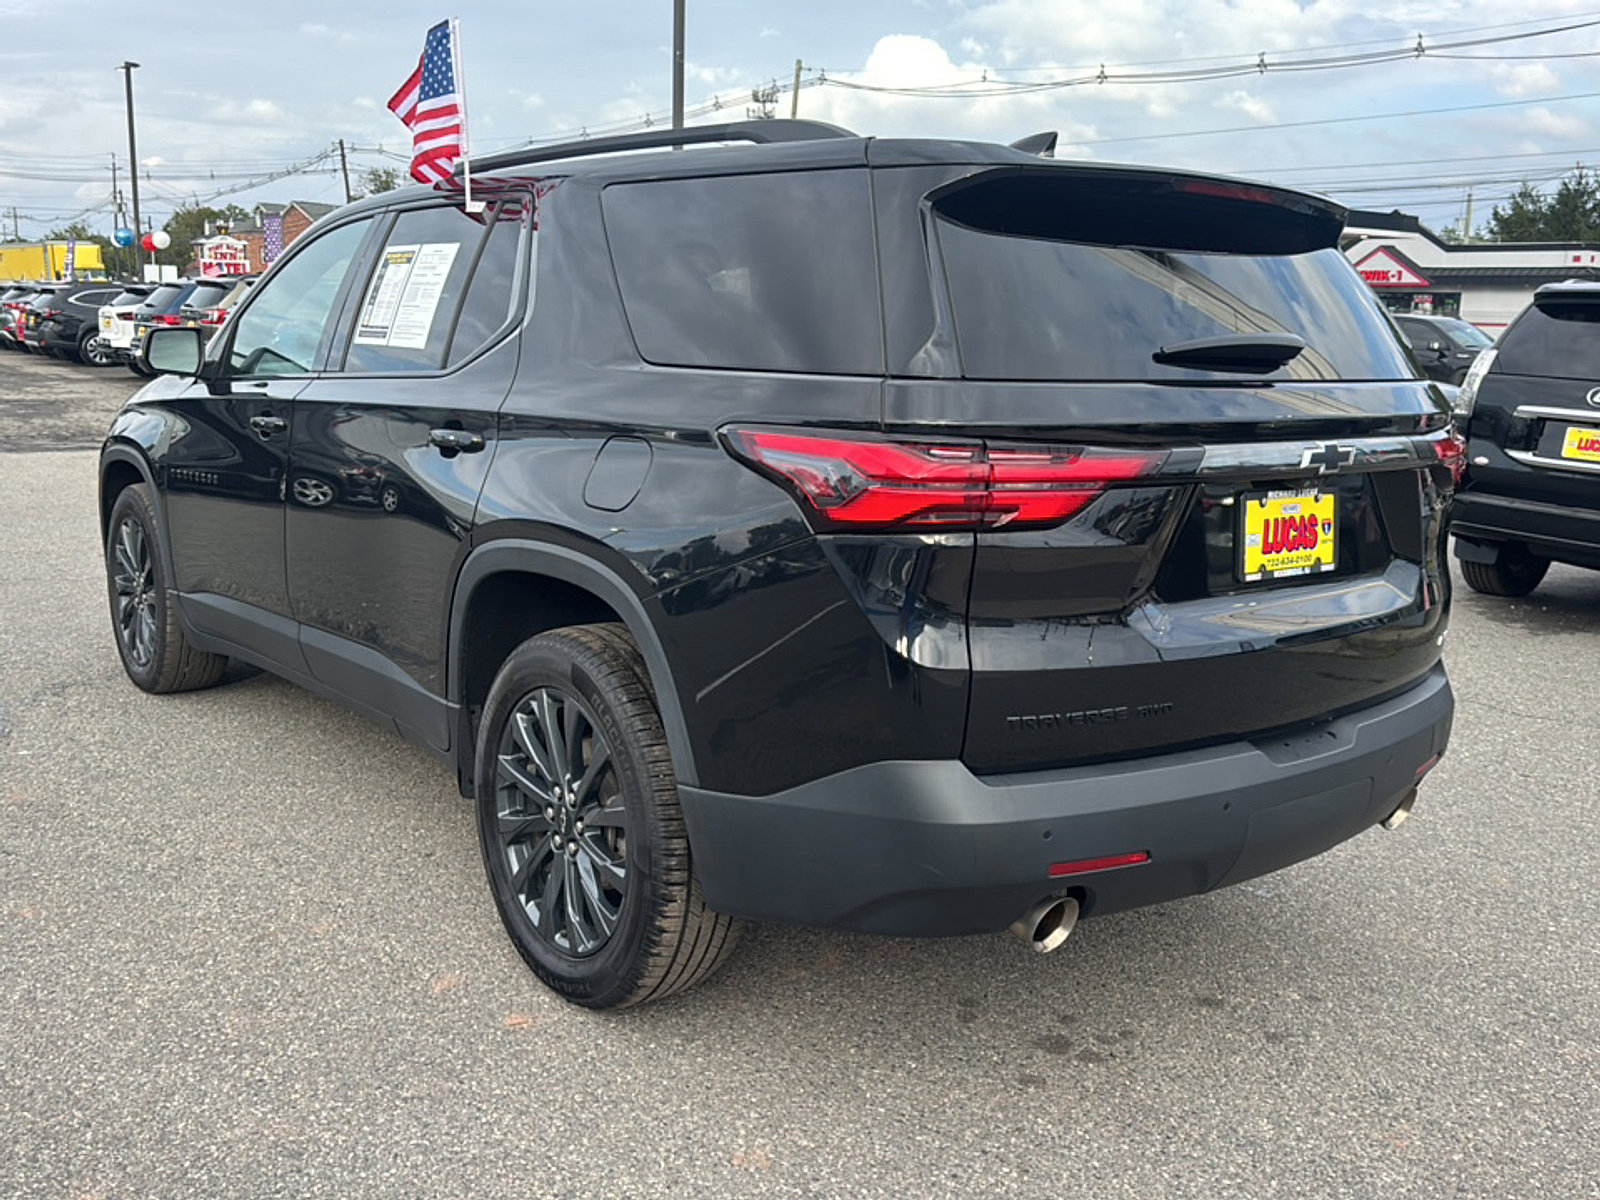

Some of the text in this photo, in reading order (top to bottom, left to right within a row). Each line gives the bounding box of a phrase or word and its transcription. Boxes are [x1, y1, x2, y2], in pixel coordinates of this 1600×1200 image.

[214, 252, 237, 261] INN
[203, 262, 246, 275] MTEL
[1262, 514, 1318, 554] LUCAS
[1006, 706, 1128, 730] TRAVERSE
